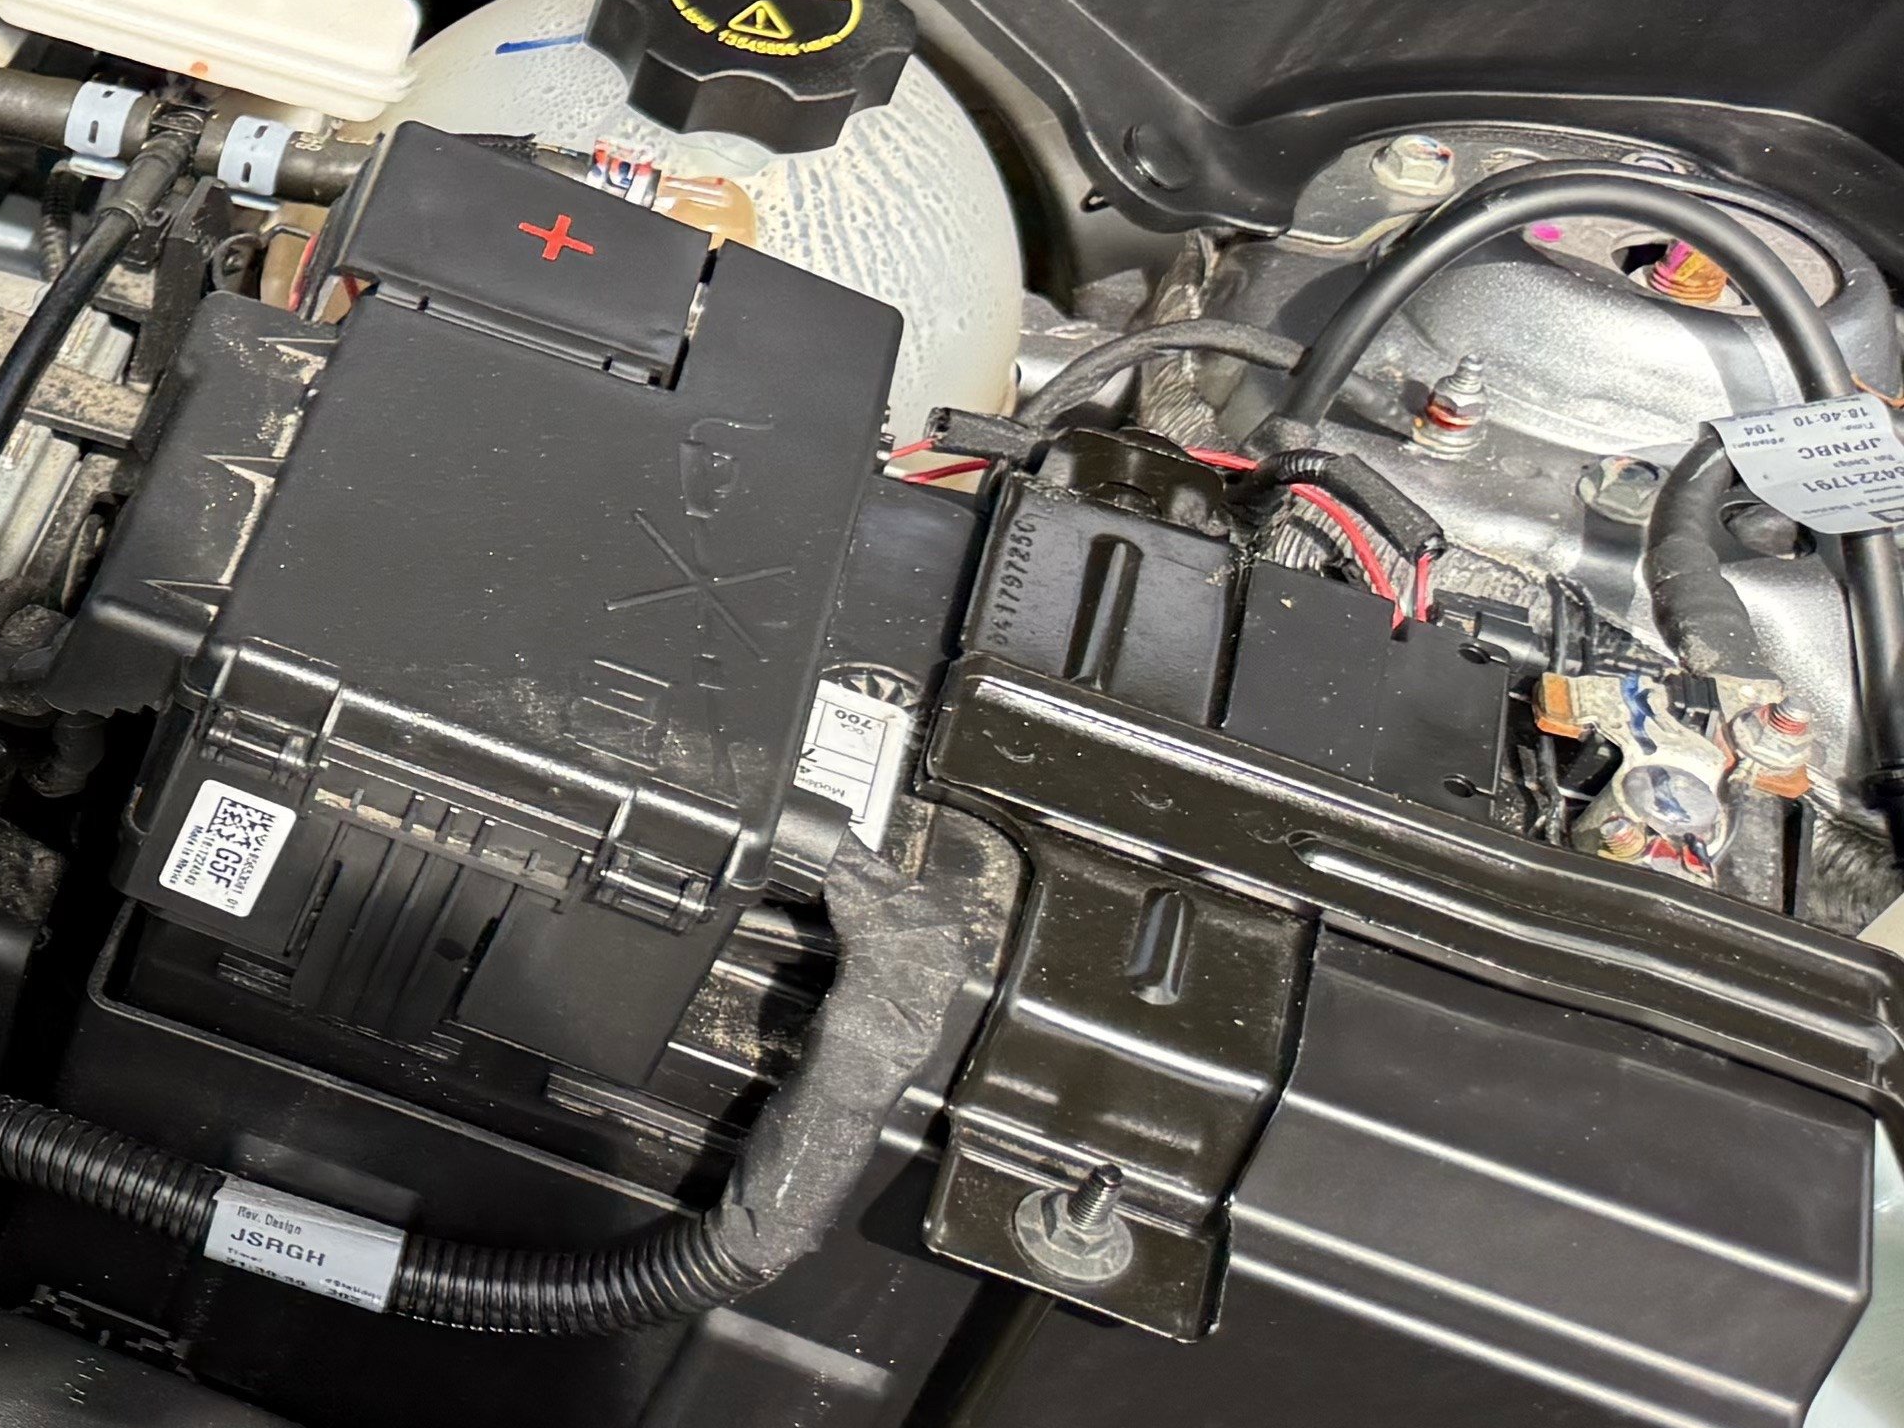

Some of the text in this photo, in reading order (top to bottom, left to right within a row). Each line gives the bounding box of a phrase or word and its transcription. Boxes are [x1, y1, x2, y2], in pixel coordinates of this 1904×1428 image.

[1796, 436, 1881, 460] JPNBC
[833, 708, 873, 729] 700
[205, 846, 243, 888] G5F
[264, 1213, 302, 1237] Design
[229, 1224, 326, 1268] JSRGH
